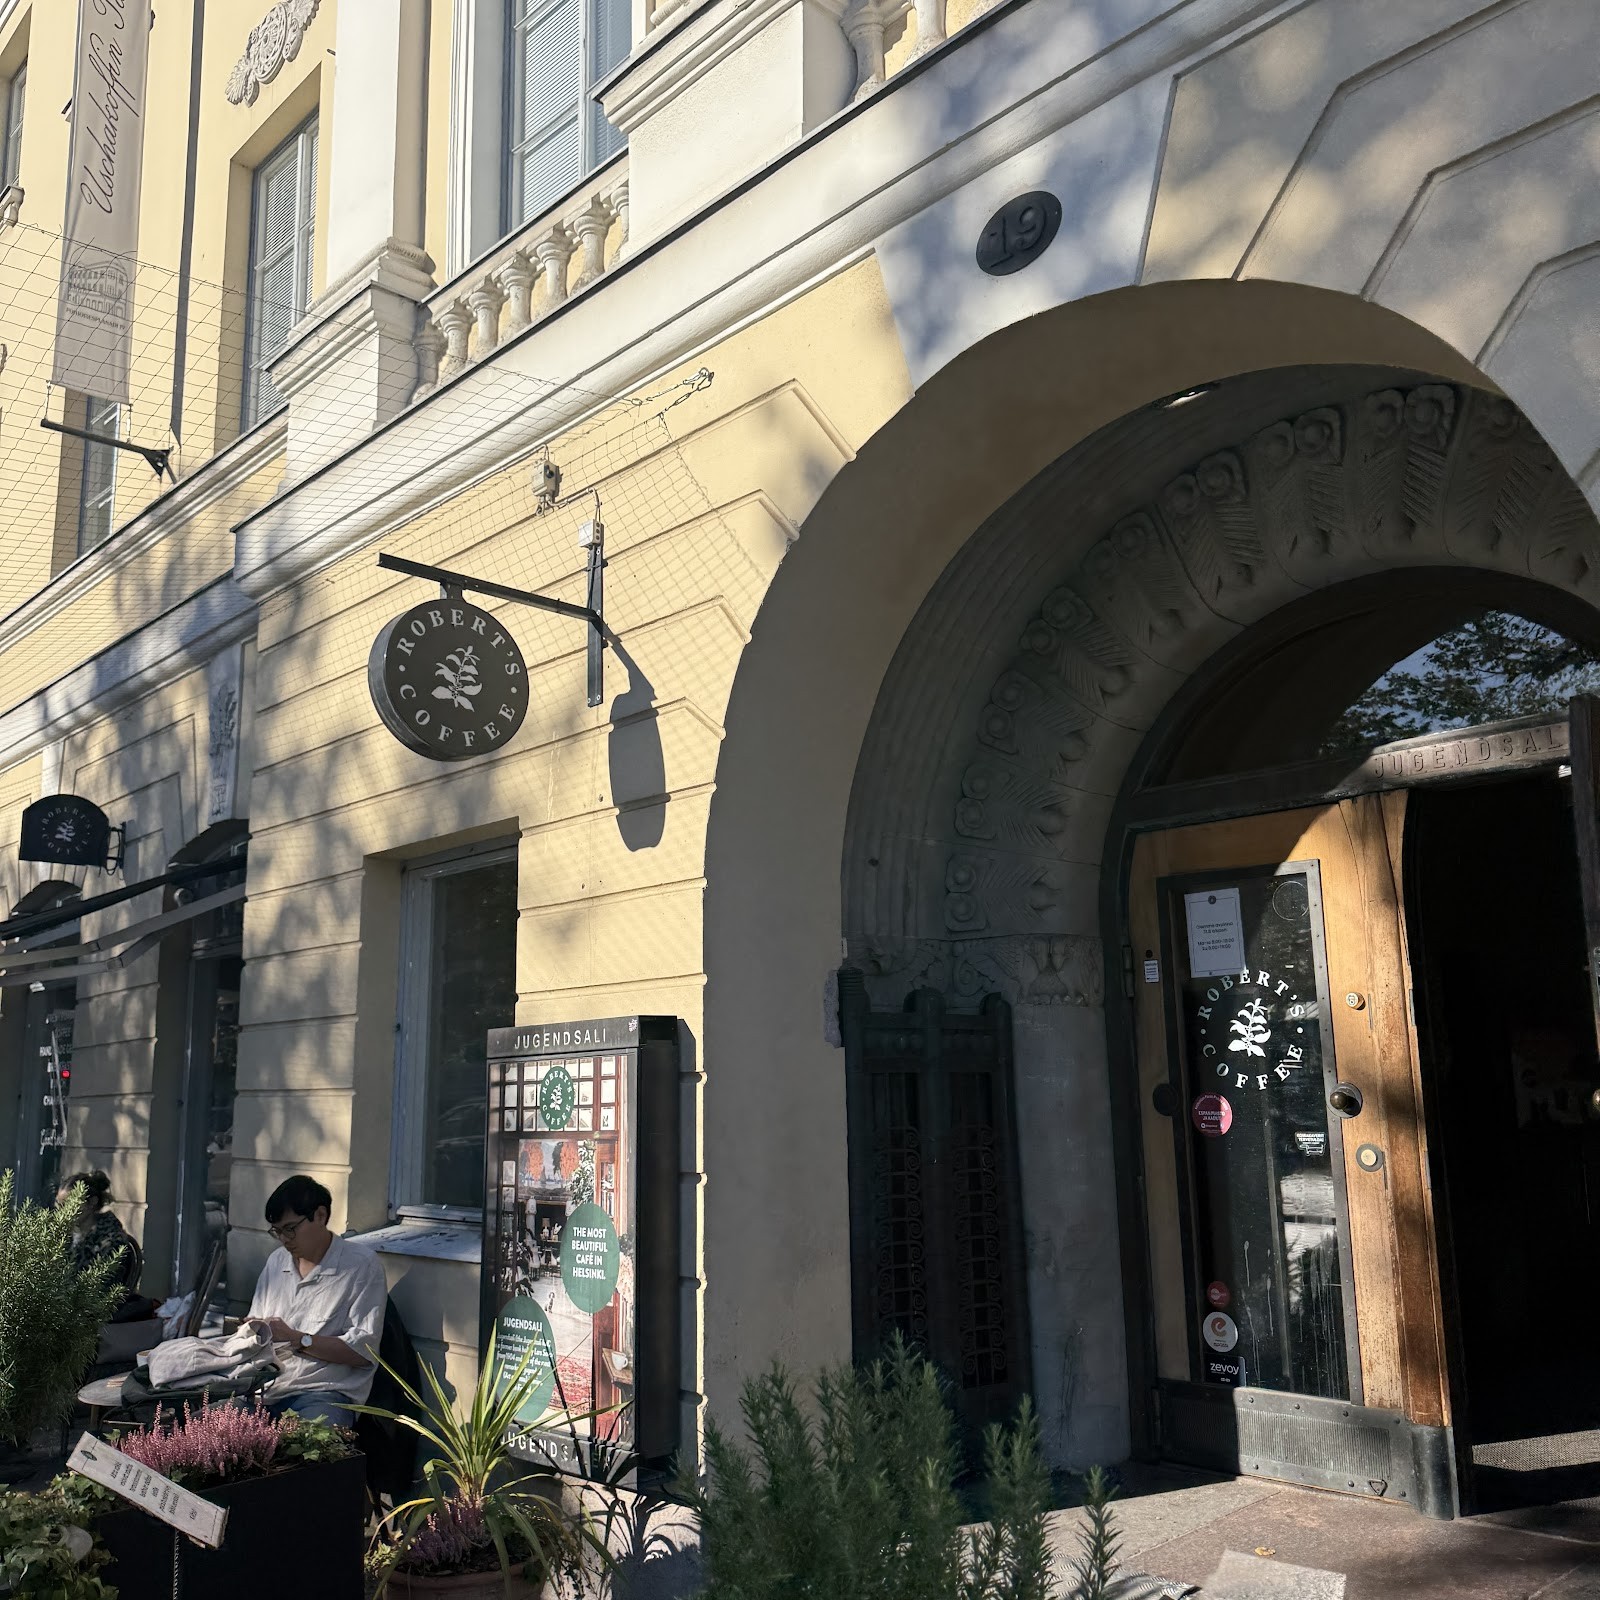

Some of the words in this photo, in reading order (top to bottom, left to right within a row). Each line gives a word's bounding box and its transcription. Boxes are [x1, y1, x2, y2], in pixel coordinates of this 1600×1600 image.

[987, 204, 1047, 270] 19
[396, 608, 521, 676] ROBERT'S
[399, 683, 517, 748] COFFEE
[1196, 969, 1305, 1021] ROBERT'S
[514, 1027, 607, 1050] JUGENDSALI
[1202, 1043, 1304, 1091] COFFEE
[541, 1070, 573, 1095] ROBERT'S
[542, 1103, 571, 1126] COFFEE
[573, 1226, 586, 1238] THE
[587, 1228, 607, 1239] MOST
[571, 1239, 609, 1253] BEAUTIFUL
[575, 1252, 593, 1265] CAFÉ
[594, 1255, 603, 1266] IN
[503, 1316, 543, 1332] JUGENDSALI
[1209, 1362, 1240, 1375] zevoy
